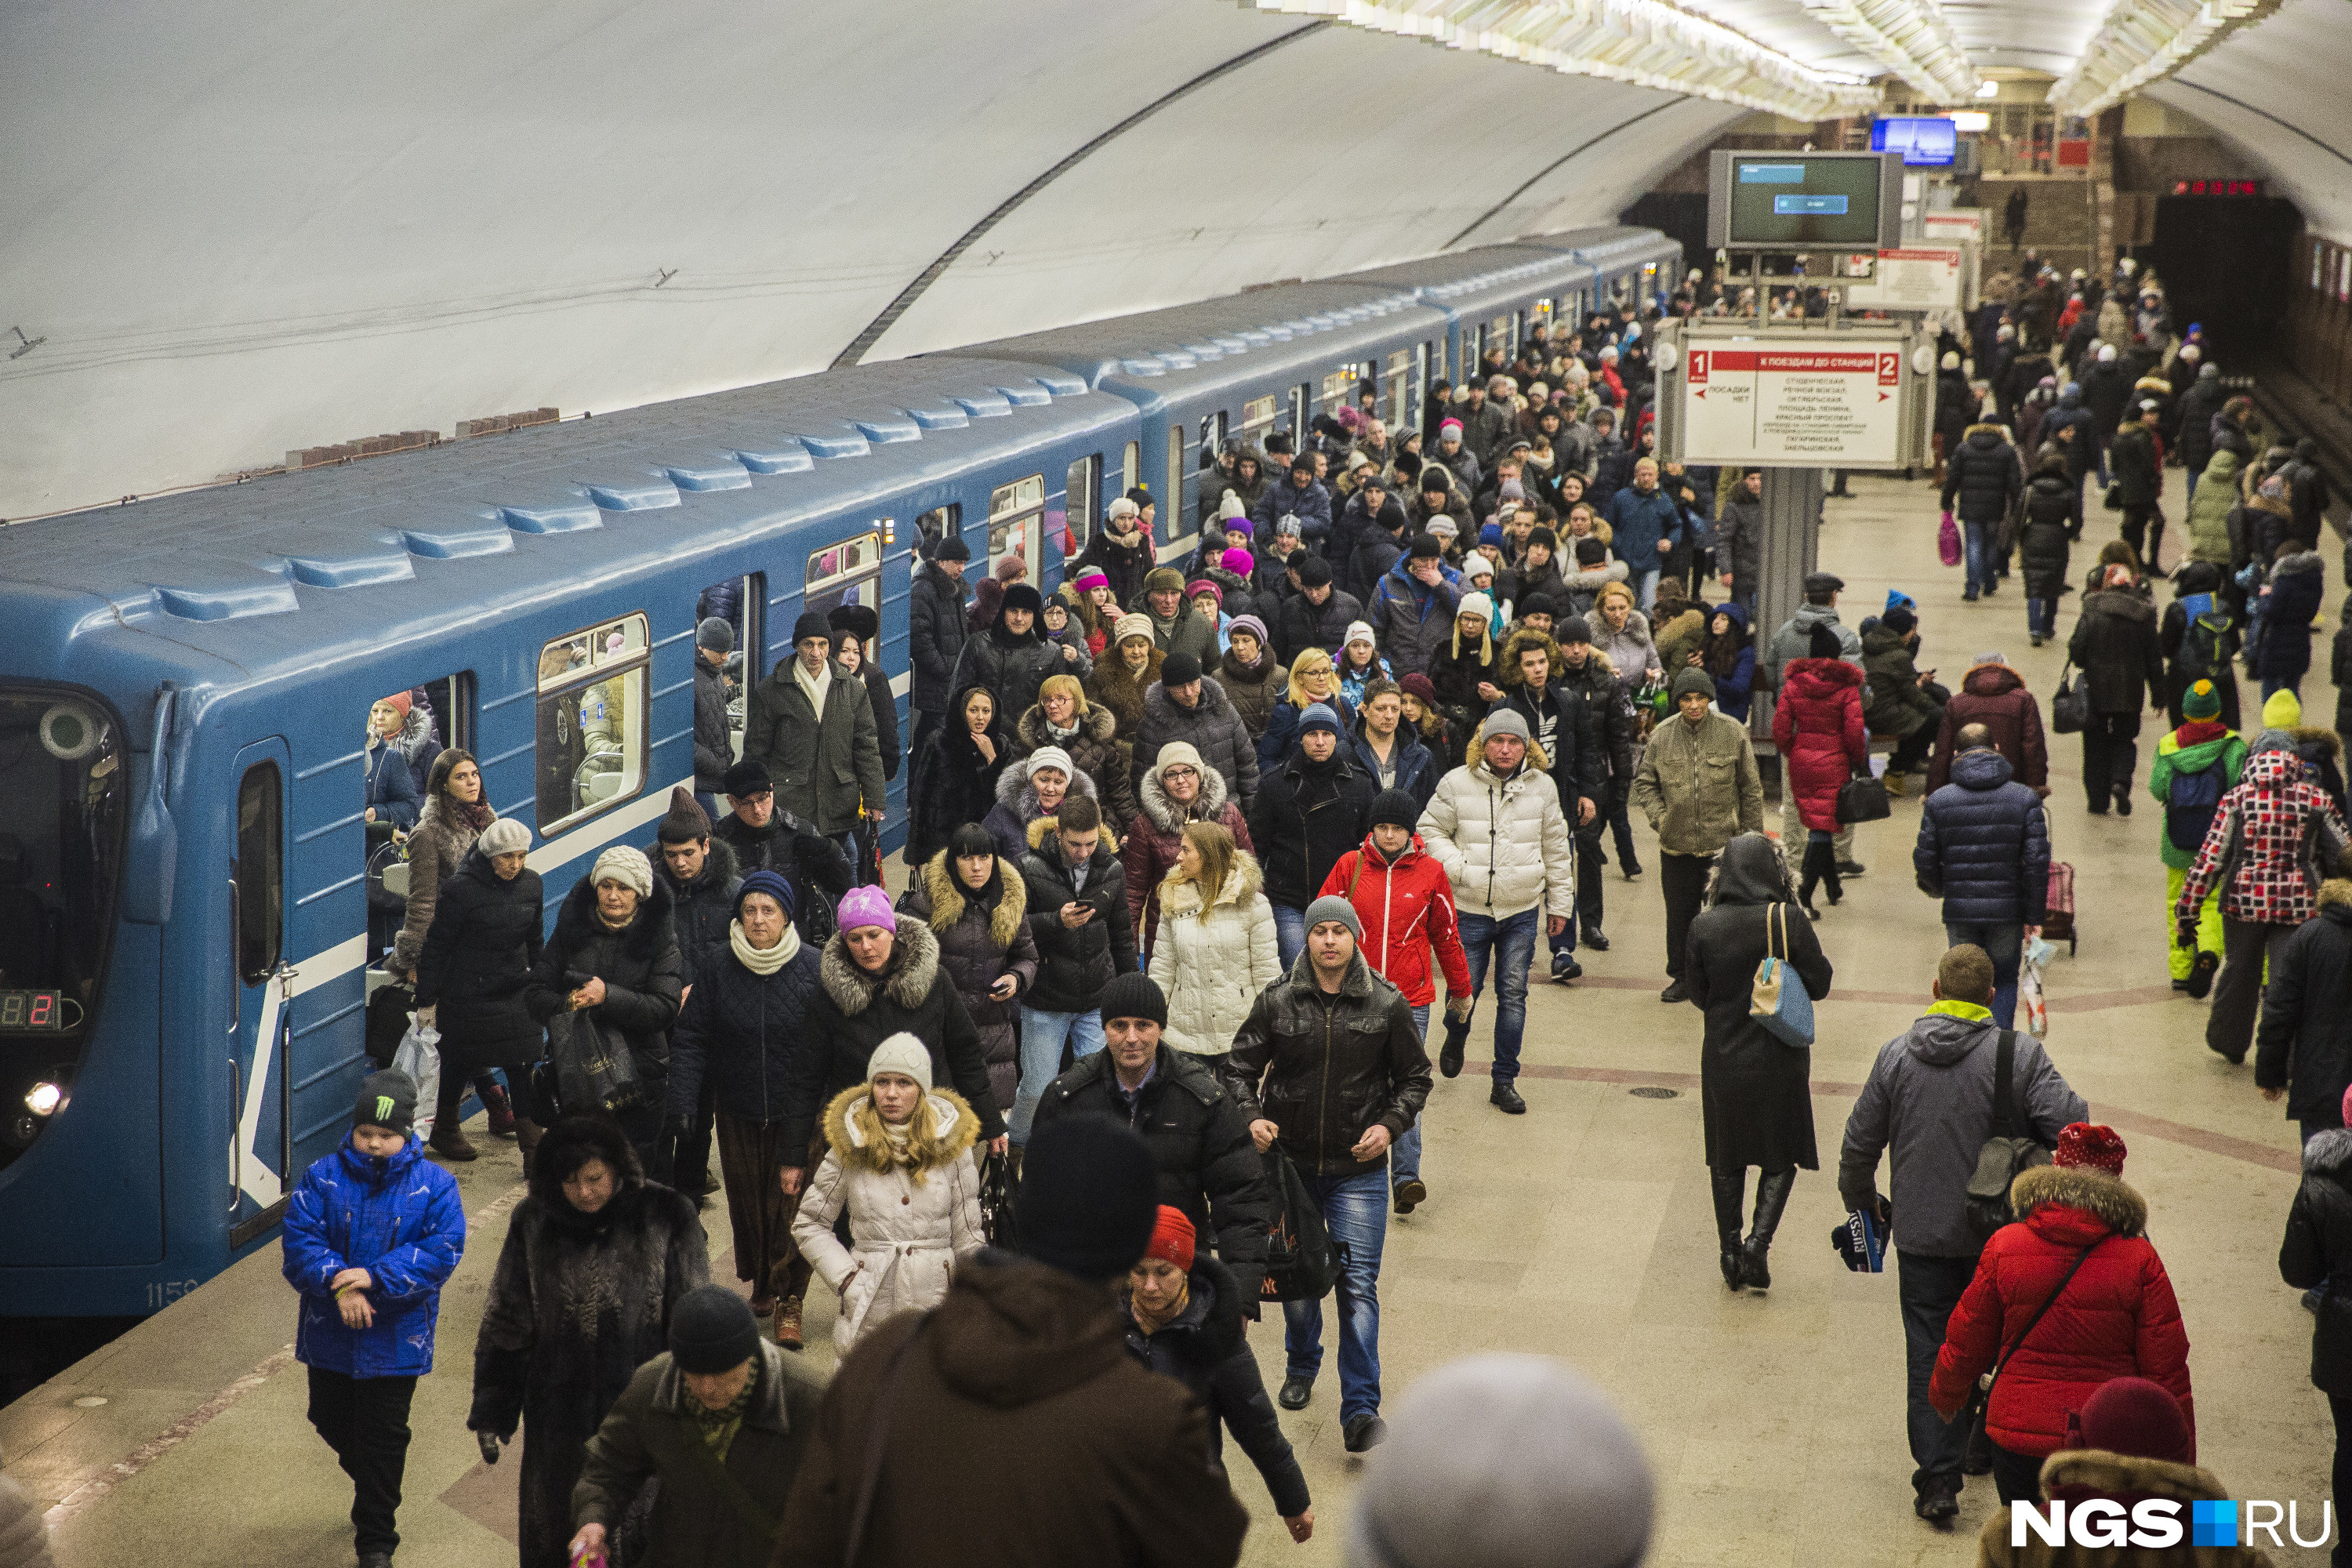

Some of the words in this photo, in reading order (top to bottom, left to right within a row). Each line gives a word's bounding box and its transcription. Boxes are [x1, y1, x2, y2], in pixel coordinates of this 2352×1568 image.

[1694, 353, 1705, 374] 1
[1760, 358, 1767, 366] К
[1769, 358, 1813, 367] ПОЕЗДАМ
[1815, 358, 1829, 368] ДО
[1881, 356, 1895, 376] 2
[31, 996, 52, 1024] 2
